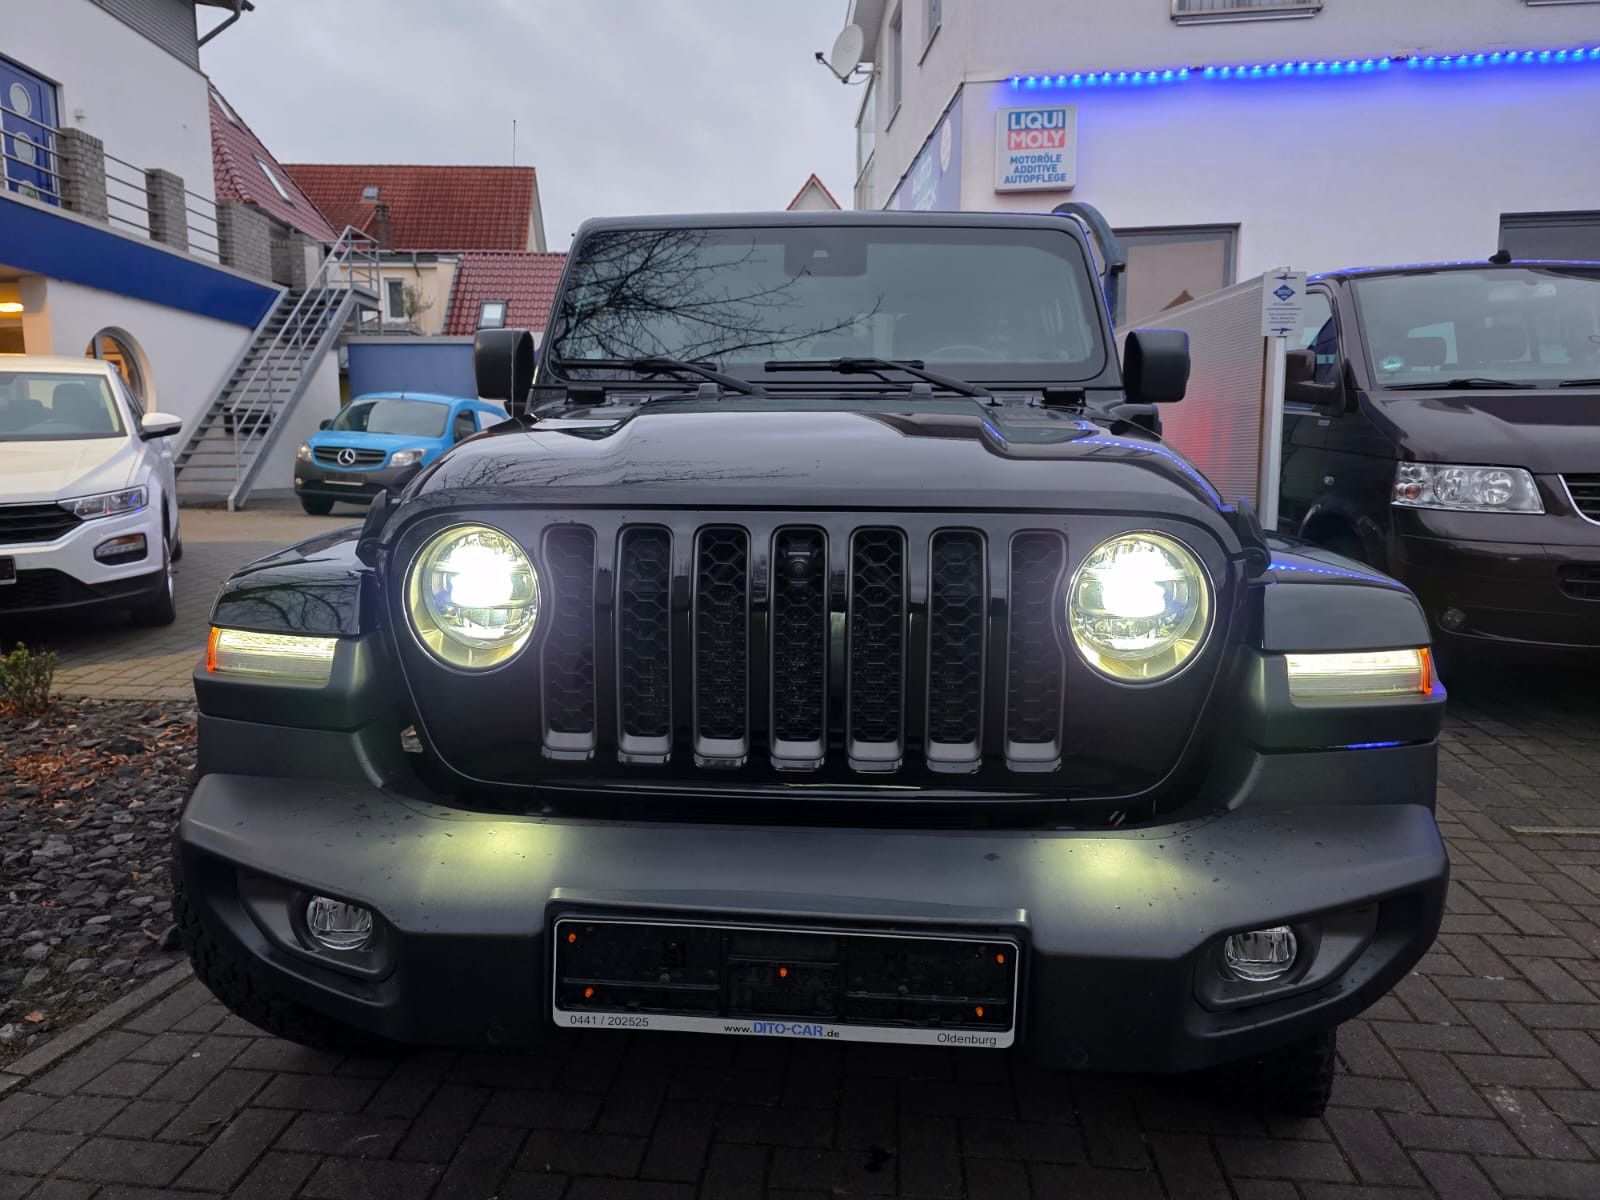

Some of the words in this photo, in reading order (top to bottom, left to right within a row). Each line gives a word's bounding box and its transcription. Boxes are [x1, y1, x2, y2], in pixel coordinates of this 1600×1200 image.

[1010, 112, 1064, 130] LIQUI
[1010, 130, 1065, 148] MOLY
[1010, 153, 1063, 165] MOTORÖLE
[1013, 164, 1058, 174] ADDITIVE
[1004, 173, 1067, 184] AUTOPFLEGE
[570, 1015, 597, 1025] 0441
[608, 1016, 649, 1027] 202525
[723, 1021, 840, 1038] www.DITO-CAR.de
[937, 1032, 997, 1047] Oldenburg
